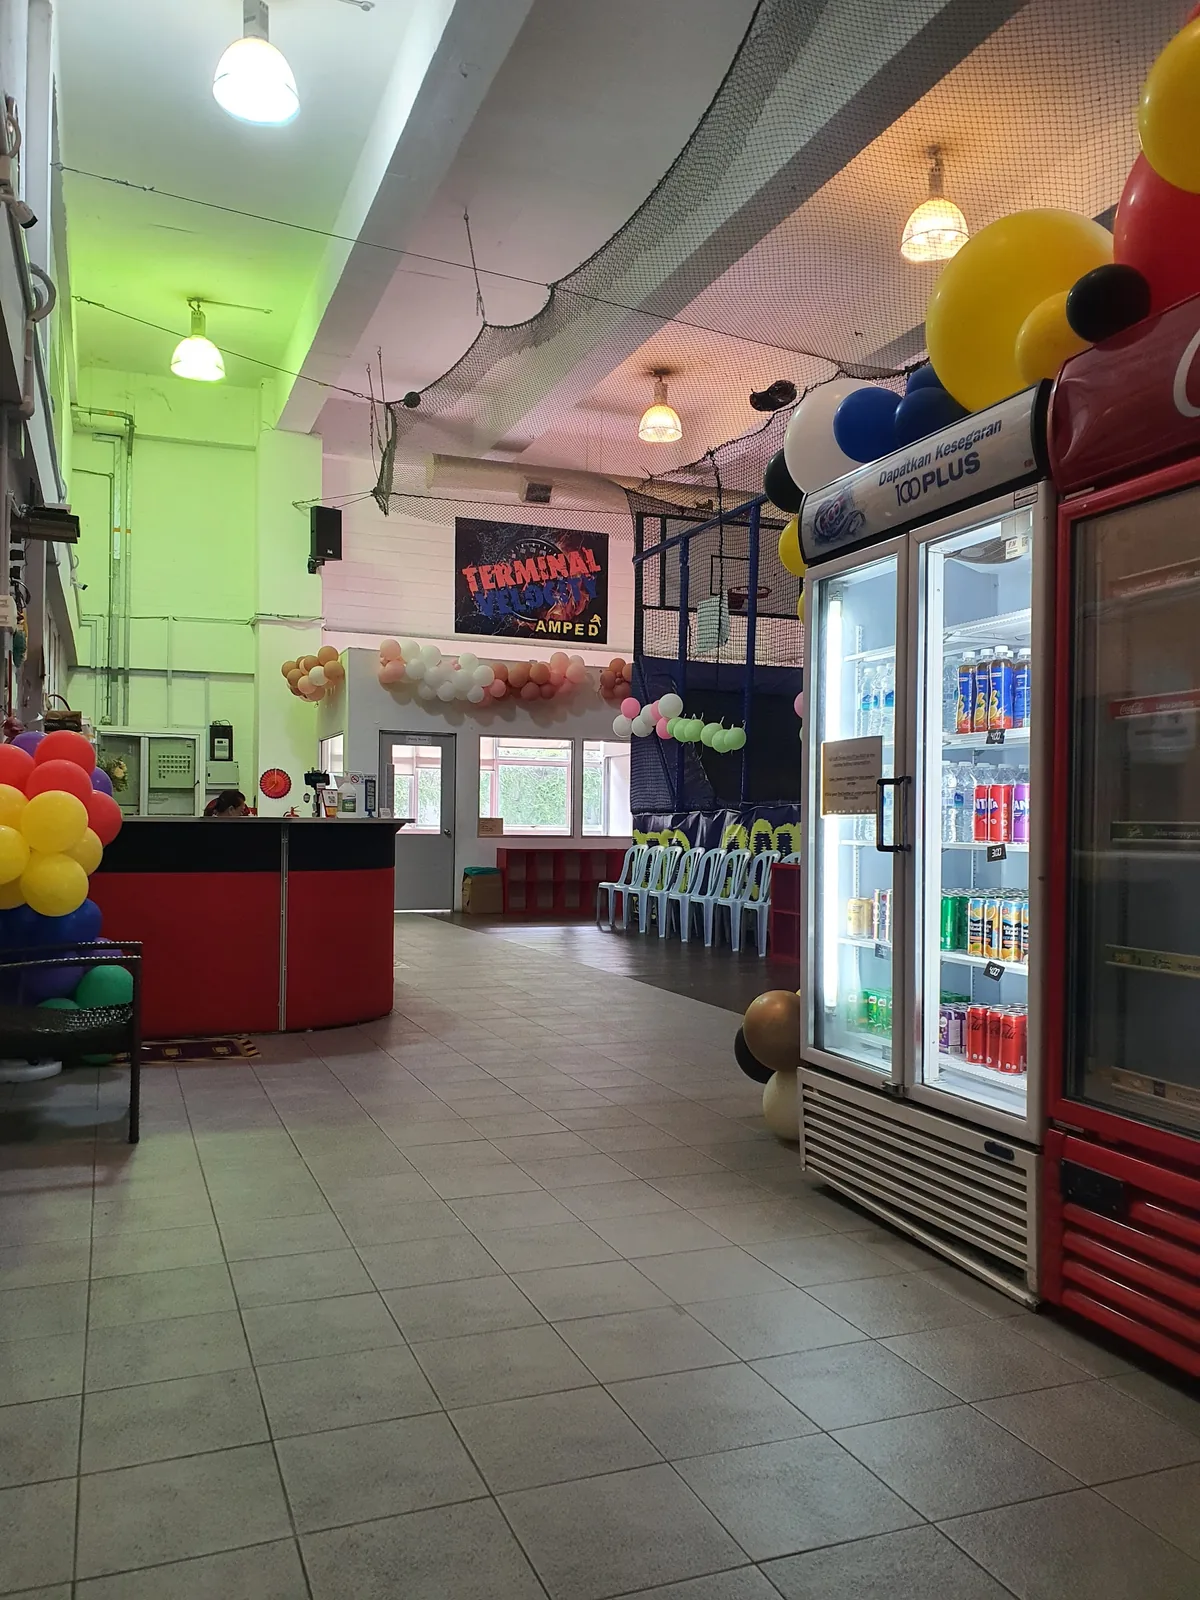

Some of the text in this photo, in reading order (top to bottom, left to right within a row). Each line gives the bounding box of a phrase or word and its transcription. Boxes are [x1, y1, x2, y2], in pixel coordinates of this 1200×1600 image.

[879, 420, 1002, 486] Dapatkan Kesegaran
[462, 547, 601, 593] TERMINAL
[473, 576, 598, 616] VELOCITY
[535, 620, 600, 637] AMPED
